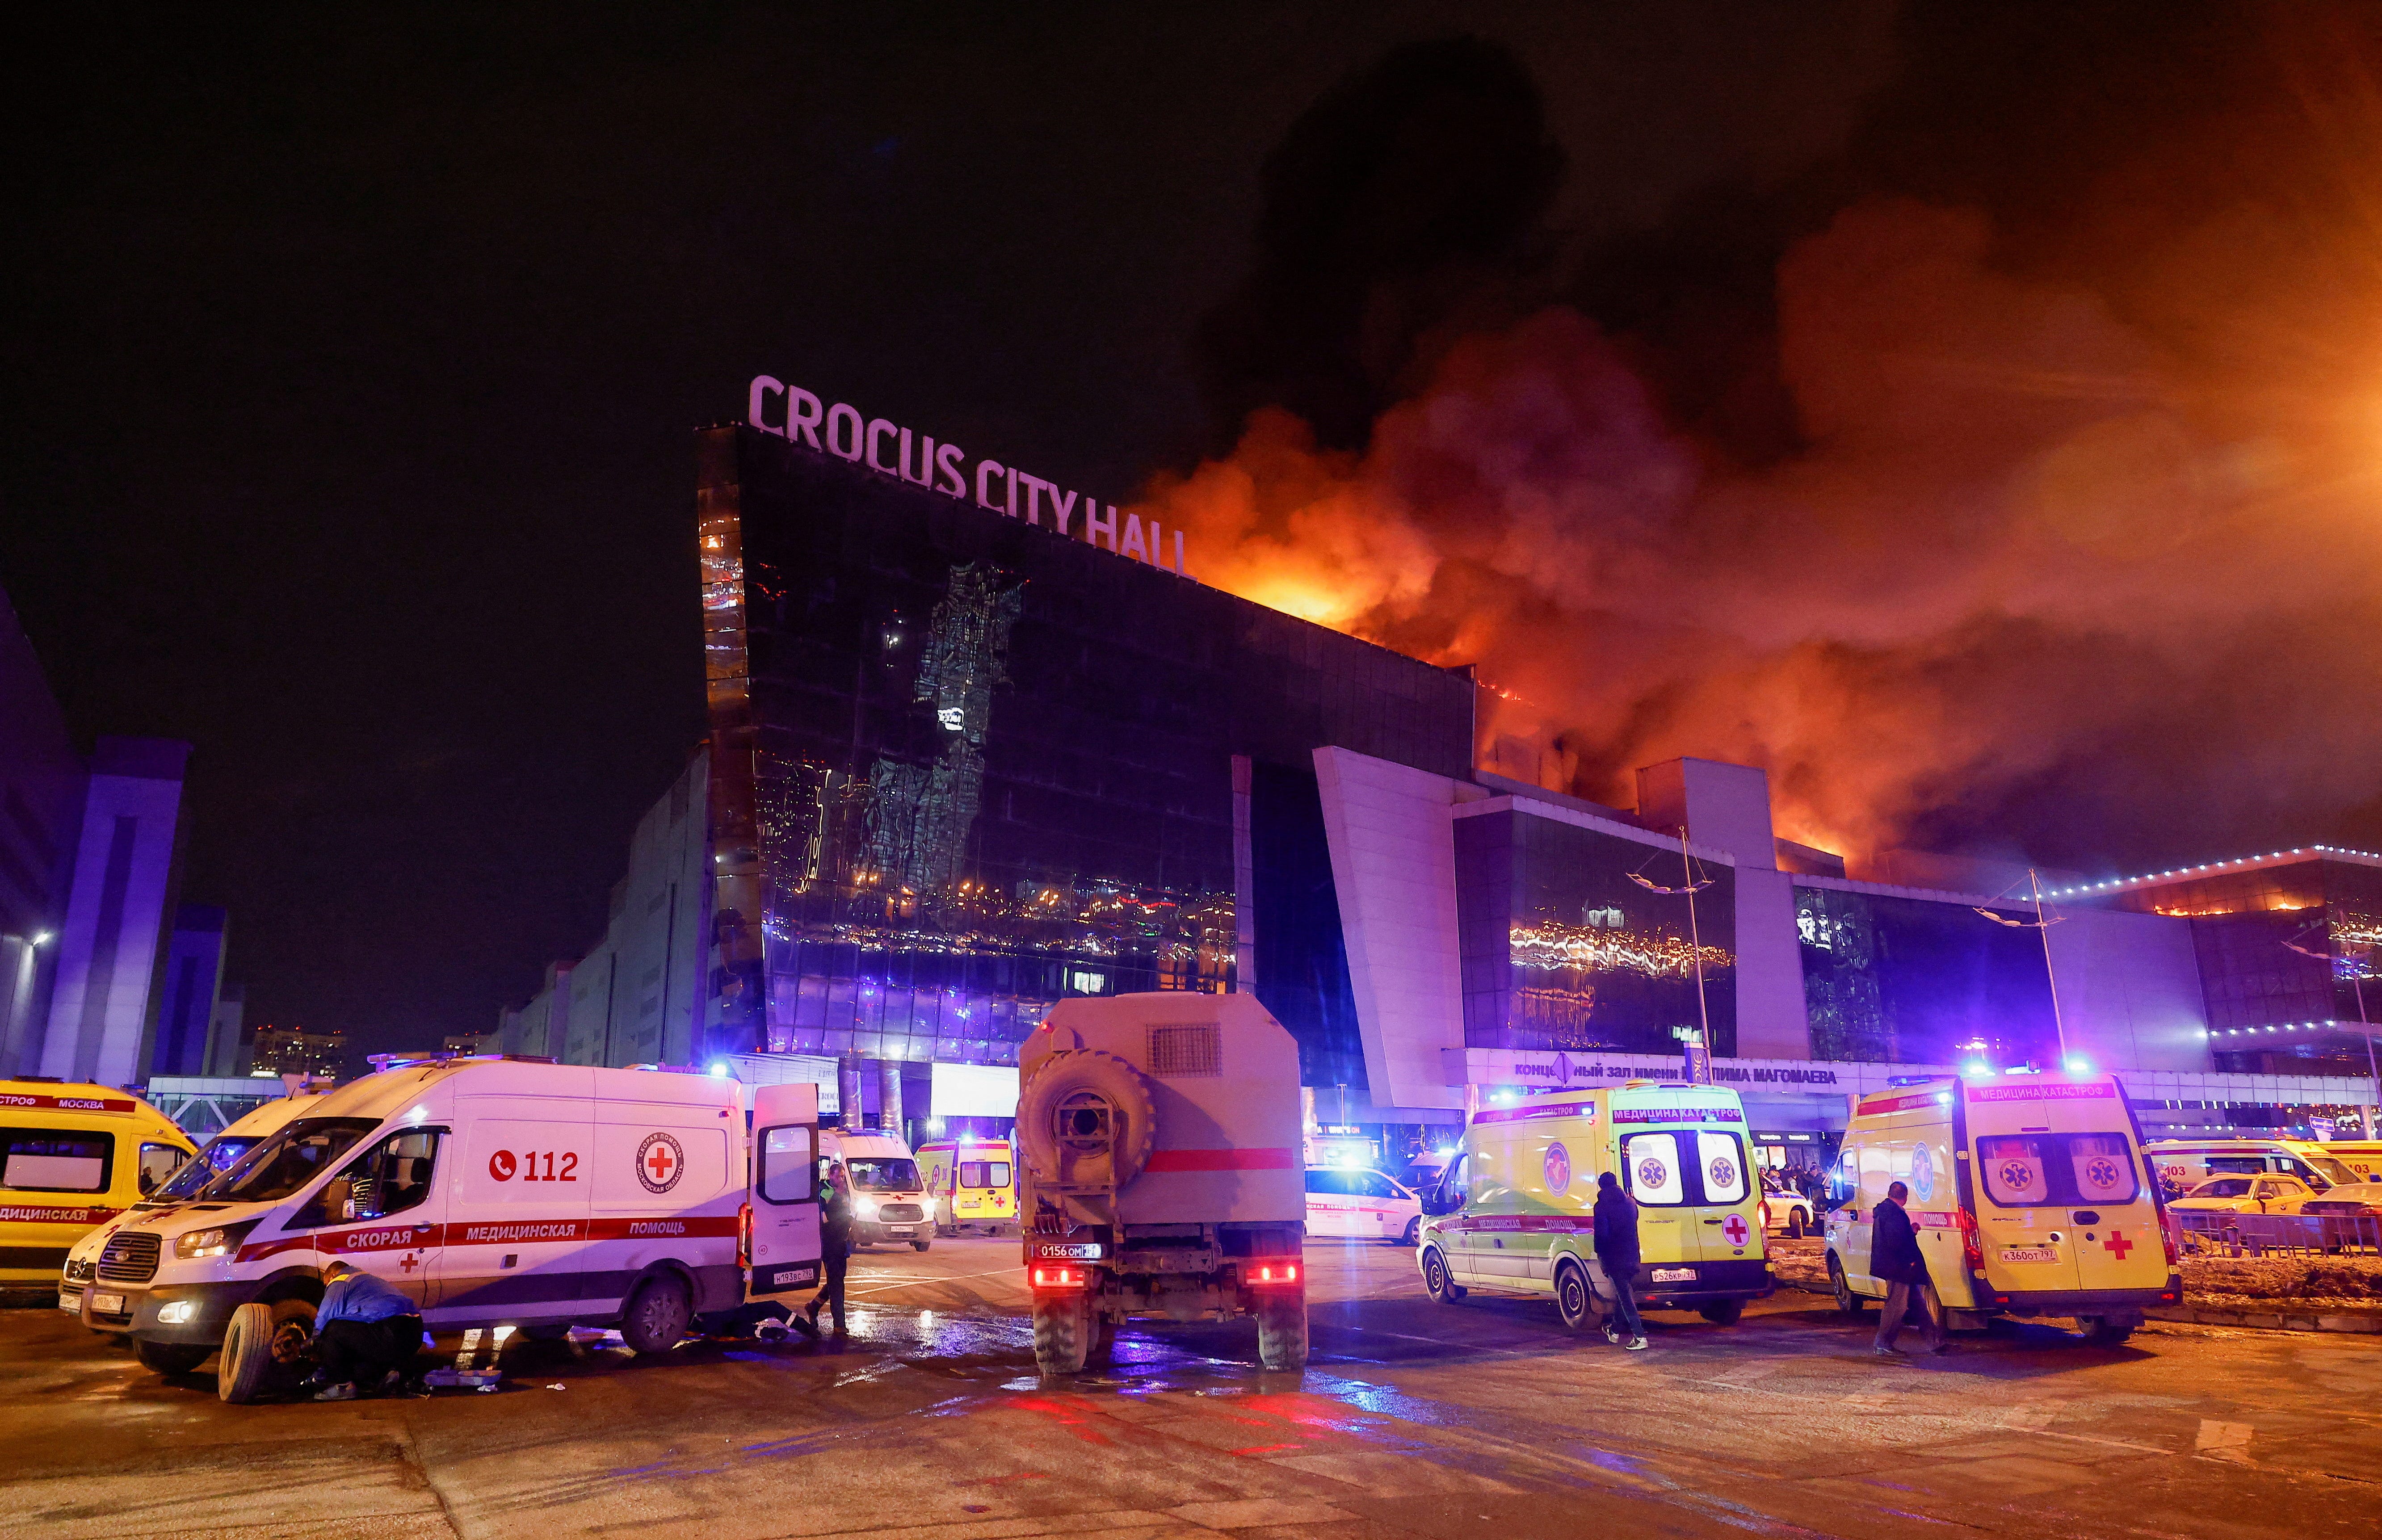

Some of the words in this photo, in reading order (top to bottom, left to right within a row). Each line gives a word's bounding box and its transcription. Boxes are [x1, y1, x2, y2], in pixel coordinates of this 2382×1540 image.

[749, 374, 966, 499] CROCUS
[976, 458, 1078, 536] CITY
[1086, 497, 1198, 581] HALL
[1515, 1063, 1604, 1078] концный
[1607, 1066, 1631, 1078] зал
[1635, 1066, 1678, 1079] имени
[1682, 1066, 1751, 1082] ЛИМА
[1753, 1068, 1837, 1084] МАГОМАЕВА
[1980, 1087, 2041, 1101] МЕДИЦИНА
[2043, 1086, 2104, 1097] КАТАСТРОФ
[59, 1099, 105, 1110] МОСКВА
[1613, 1109, 1680, 1120] МЕДИЦИНА
[1680, 1109, 1740, 1117] КАТАСТРОФ
[638, 1134, 658, 1157] СКОРАЯ
[660, 1133, 683, 1158] ПОМОЩЬ
[524, 1151, 578, 1181] 112
[2165, 1166, 2186, 1176] 103
[637, 1163, 664, 1192] МОСКОВСКАЯ
[665, 1164, 683, 1191] ОБЛАСТЬ
[1478, 1219, 1521, 1229] МЕДИЦИНСКАЯ
[1545, 1220, 1576, 1231] ПОМОЩЬ
[1923, 1213, 1947, 1227] ПОМОЩЬ
[346, 1230, 412, 1248] СКОРАЯ
[466, 1224, 576, 1242] МЕДИЦИНСКАЯ
[629, 1222, 685, 1235] ПОМОЩЬ
[1042, 1246, 1067, 1256] 0156
[2004, 1251, 2038, 1260] К360ОТ
[776, 1273, 801, 1283] Н193ВС
[1654, 1271, 1681, 1280] Р526КР
